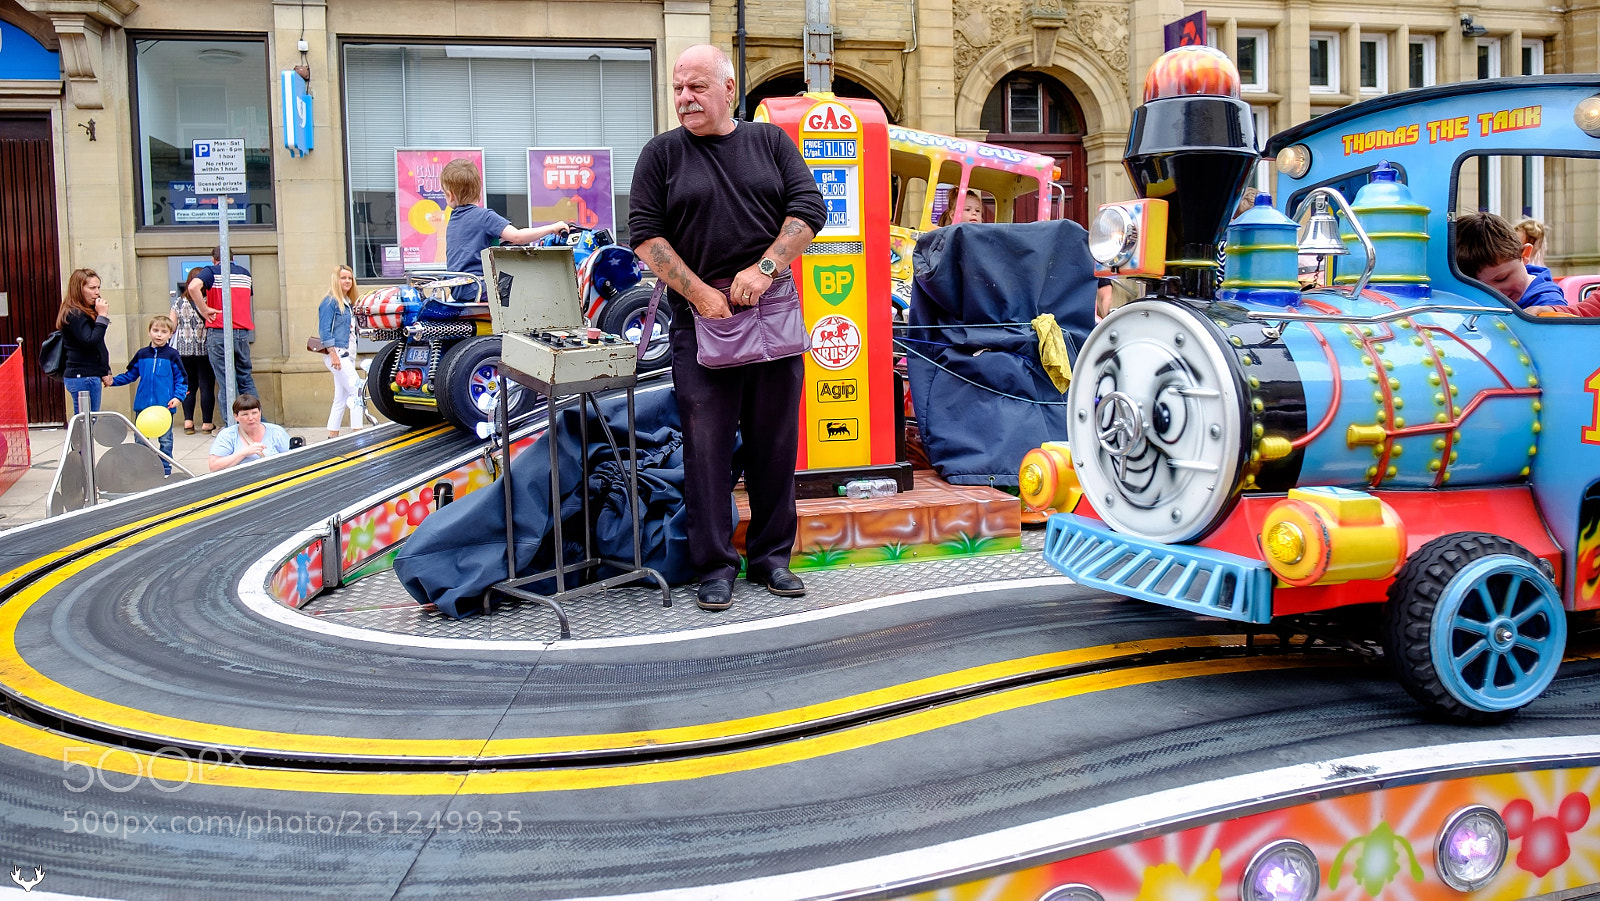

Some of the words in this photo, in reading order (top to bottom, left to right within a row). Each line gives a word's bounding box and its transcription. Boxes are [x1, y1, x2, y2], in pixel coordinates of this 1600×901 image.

[808, 106, 852, 130] GAS
[1342, 124, 1419, 156] THOMAS
[1426, 116, 1469, 144] THE
[1477, 105, 1542, 137] TANK
[825, 141, 855, 156] 1.19
[977, 145, 1028, 164] BUS
[545, 156, 567, 164] ARE
[568, 156, 591, 164] YOU
[546, 169, 591, 185] FIT?
[821, 170, 838, 183] gal.
[827, 200, 833, 211] $
[820, 271, 851, 295] BP
[820, 381, 856, 399] Agip
